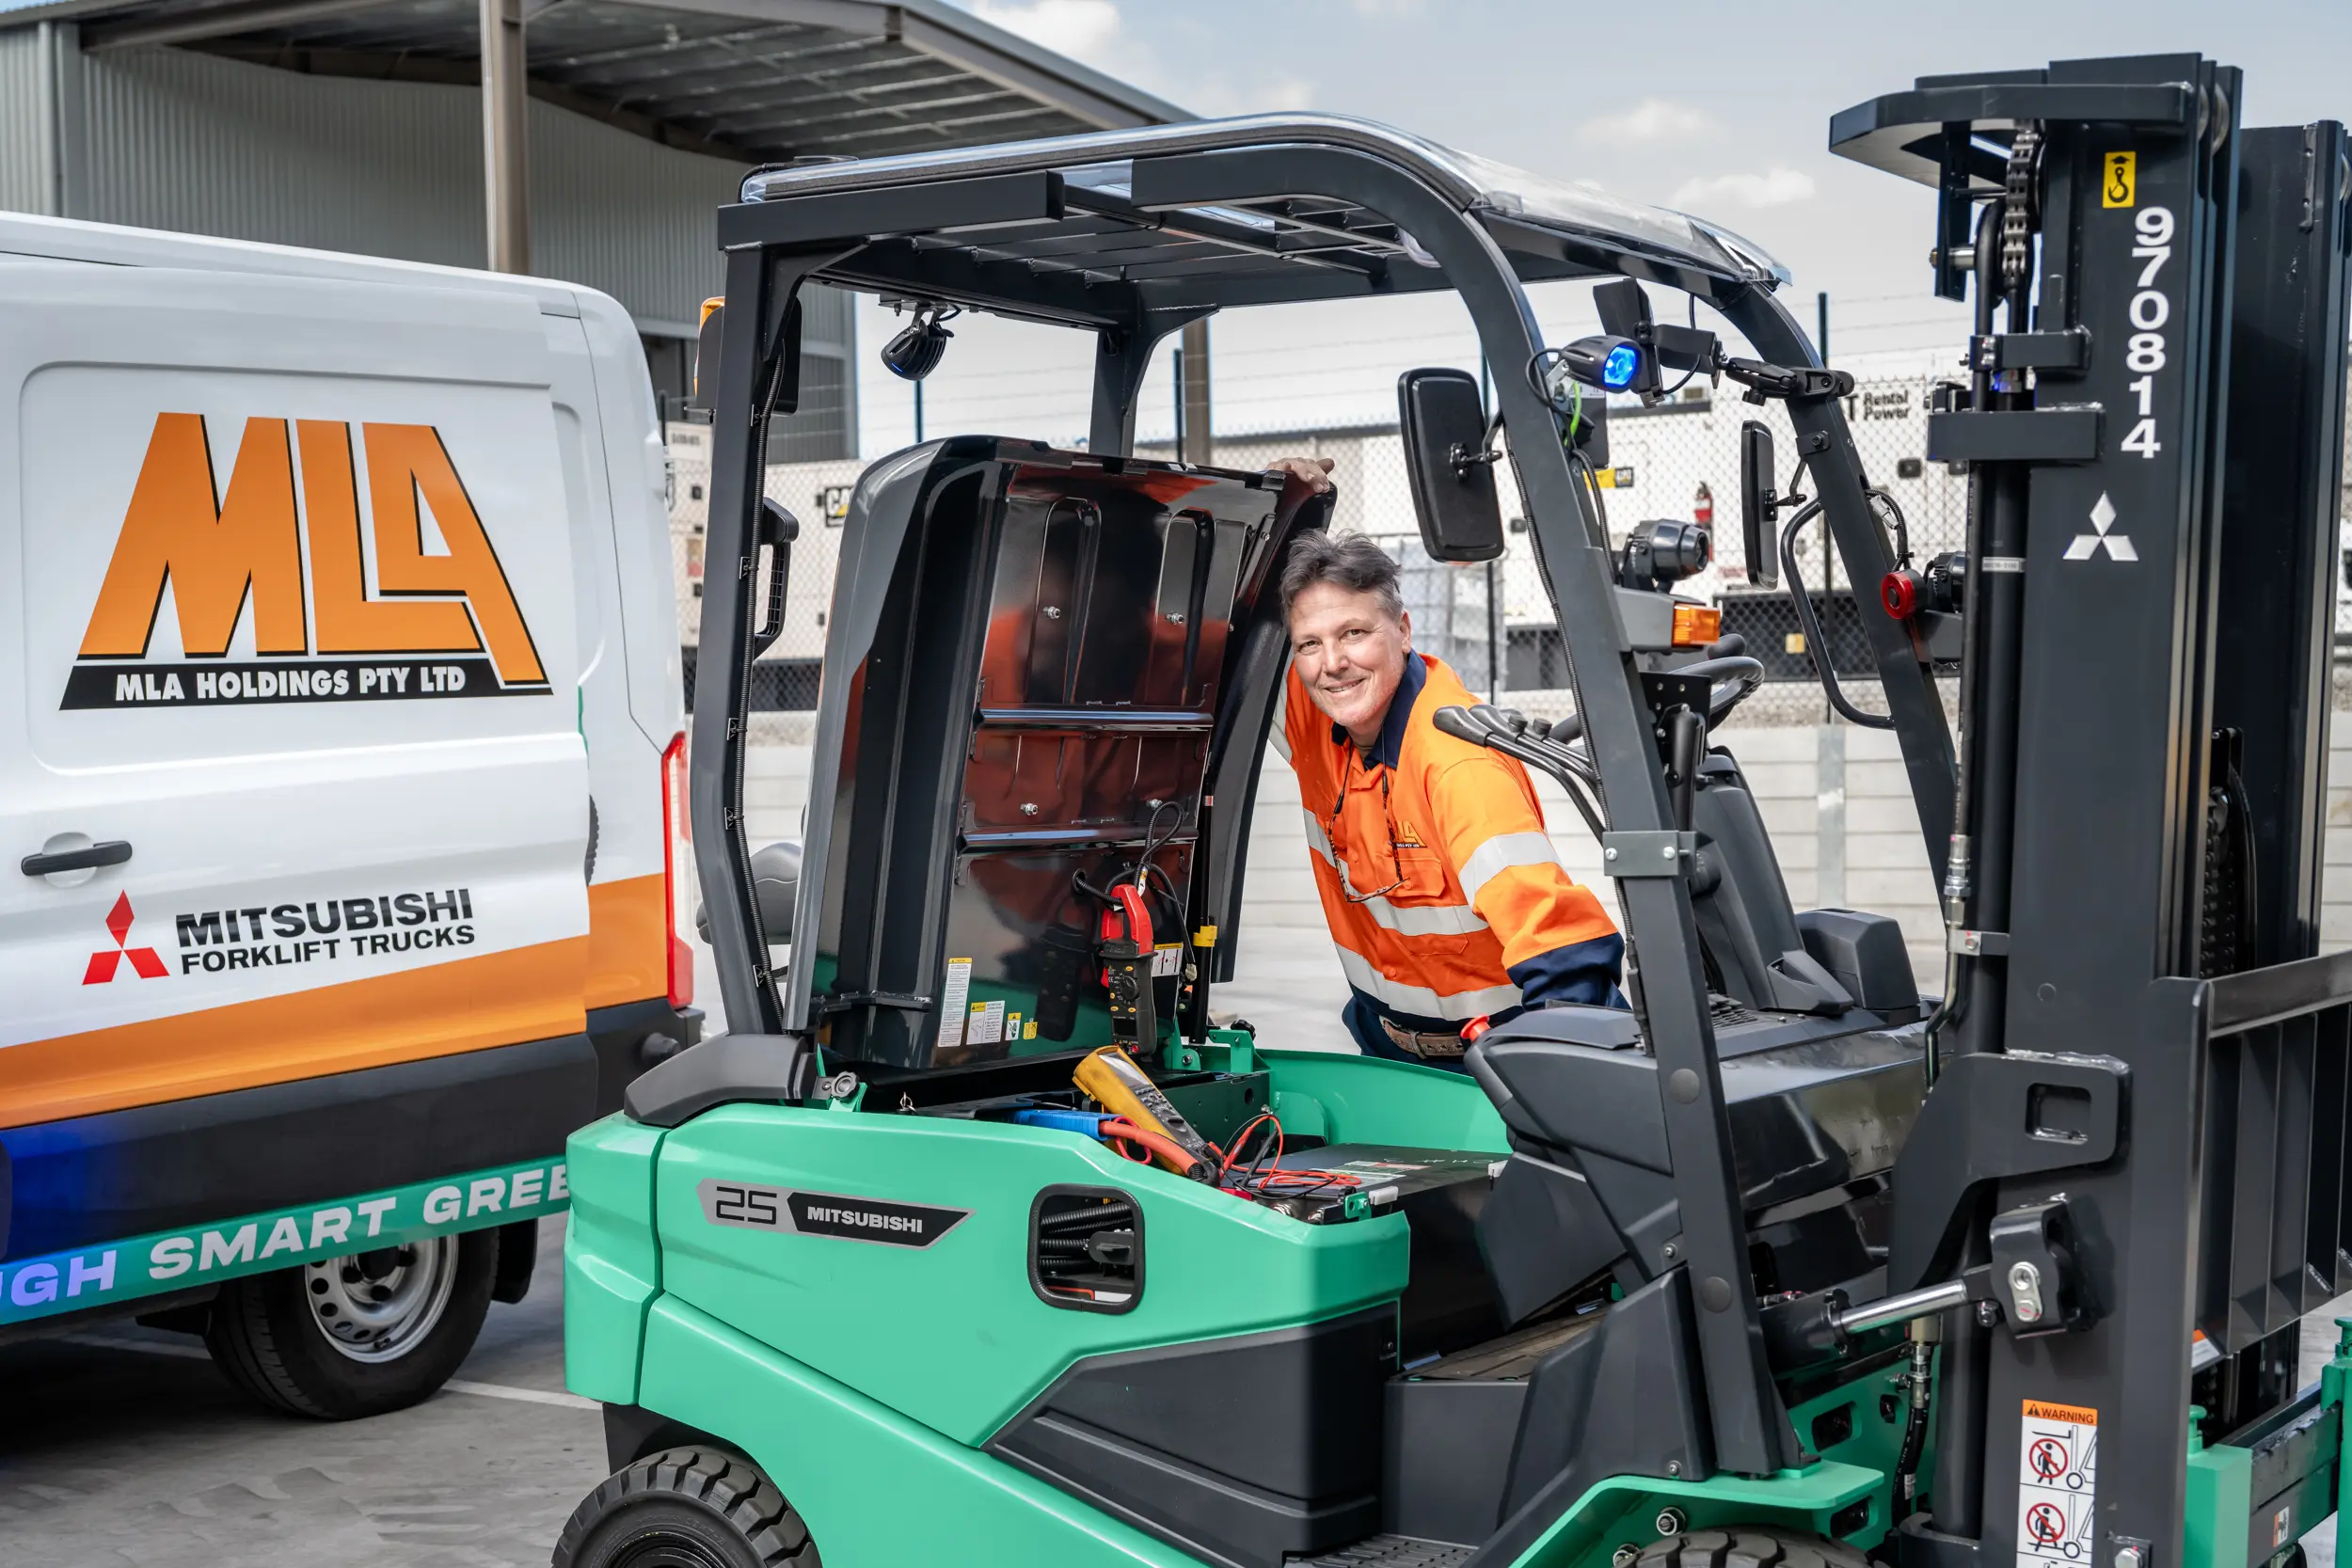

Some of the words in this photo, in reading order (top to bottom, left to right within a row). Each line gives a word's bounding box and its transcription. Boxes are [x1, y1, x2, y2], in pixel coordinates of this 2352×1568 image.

[2121, 206, 2175, 459] 970814
[1864, 389, 1909, 405] Rental
[1864, 407, 1911, 421] Power
[77, 411, 550, 685] MLA
[116, 673, 185, 701] MLA
[197, 669, 349, 699] HOLDINGS
[359, 667, 410, 694] PTY
[421, 666, 466, 691] LTD
[176, 888, 473, 948] MITSUBISHI
[182, 939, 341, 974] FORKLIFT
[350, 925, 475, 957] TRUCKS
[716, 1186, 777, 1225] 25
[807, 1206, 923, 1234] MITSUBISHI
[0, 1251, 117, 1306] GH
[149, 1197, 396, 1280] SMART
[2042, 1408, 2093, 1423] WARNING
